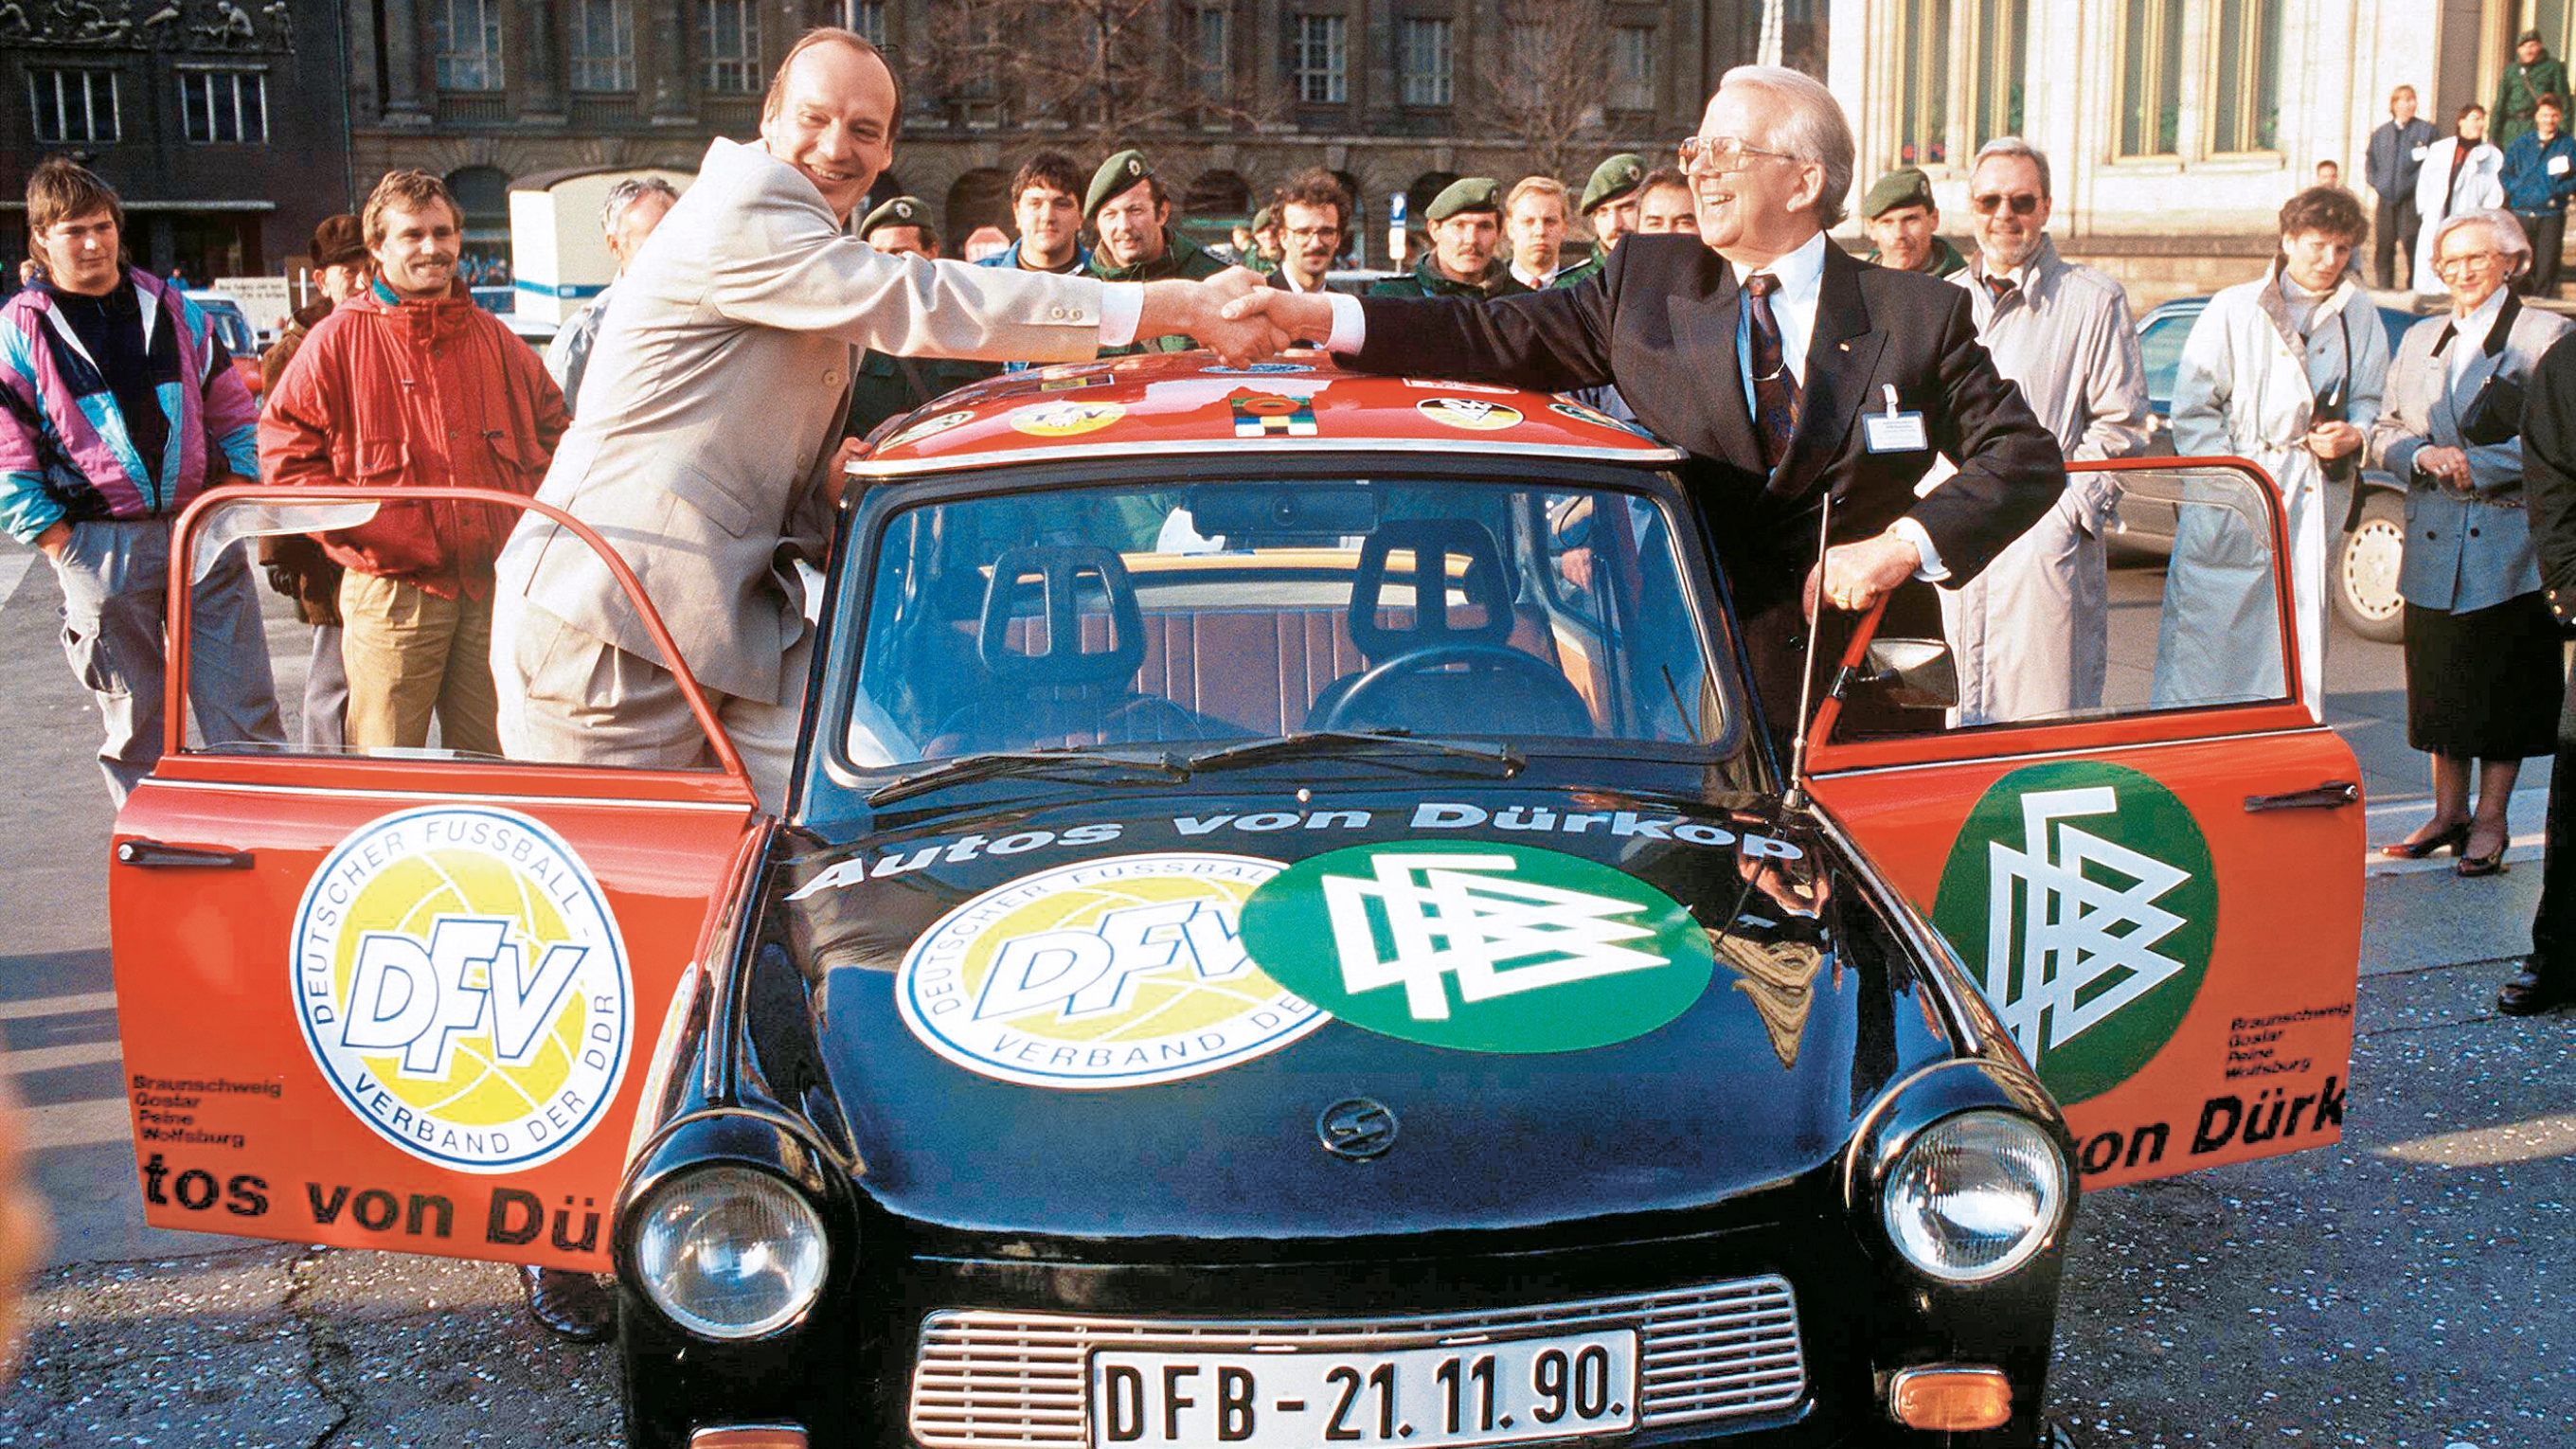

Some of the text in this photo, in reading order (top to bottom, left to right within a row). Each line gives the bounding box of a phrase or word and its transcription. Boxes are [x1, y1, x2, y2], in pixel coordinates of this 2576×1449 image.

[783, 802, 1803, 901] Autos von Dürkop
[307, 831, 405, 1025] DEUTSCHER
[922, 861, 1264, 1017] DEUTSCHER FUSSBAL
[340, 917, 592, 1074] DFV
[993, 996, 1312, 1068] VERBAND DE
[133, 1074, 282, 1098] Braunschweig
[353, 994, 616, 1154] VERBAND DER DDR
[2074, 1122, 2171, 1175] on
[143, 1153, 614, 1257] tos von Dü
